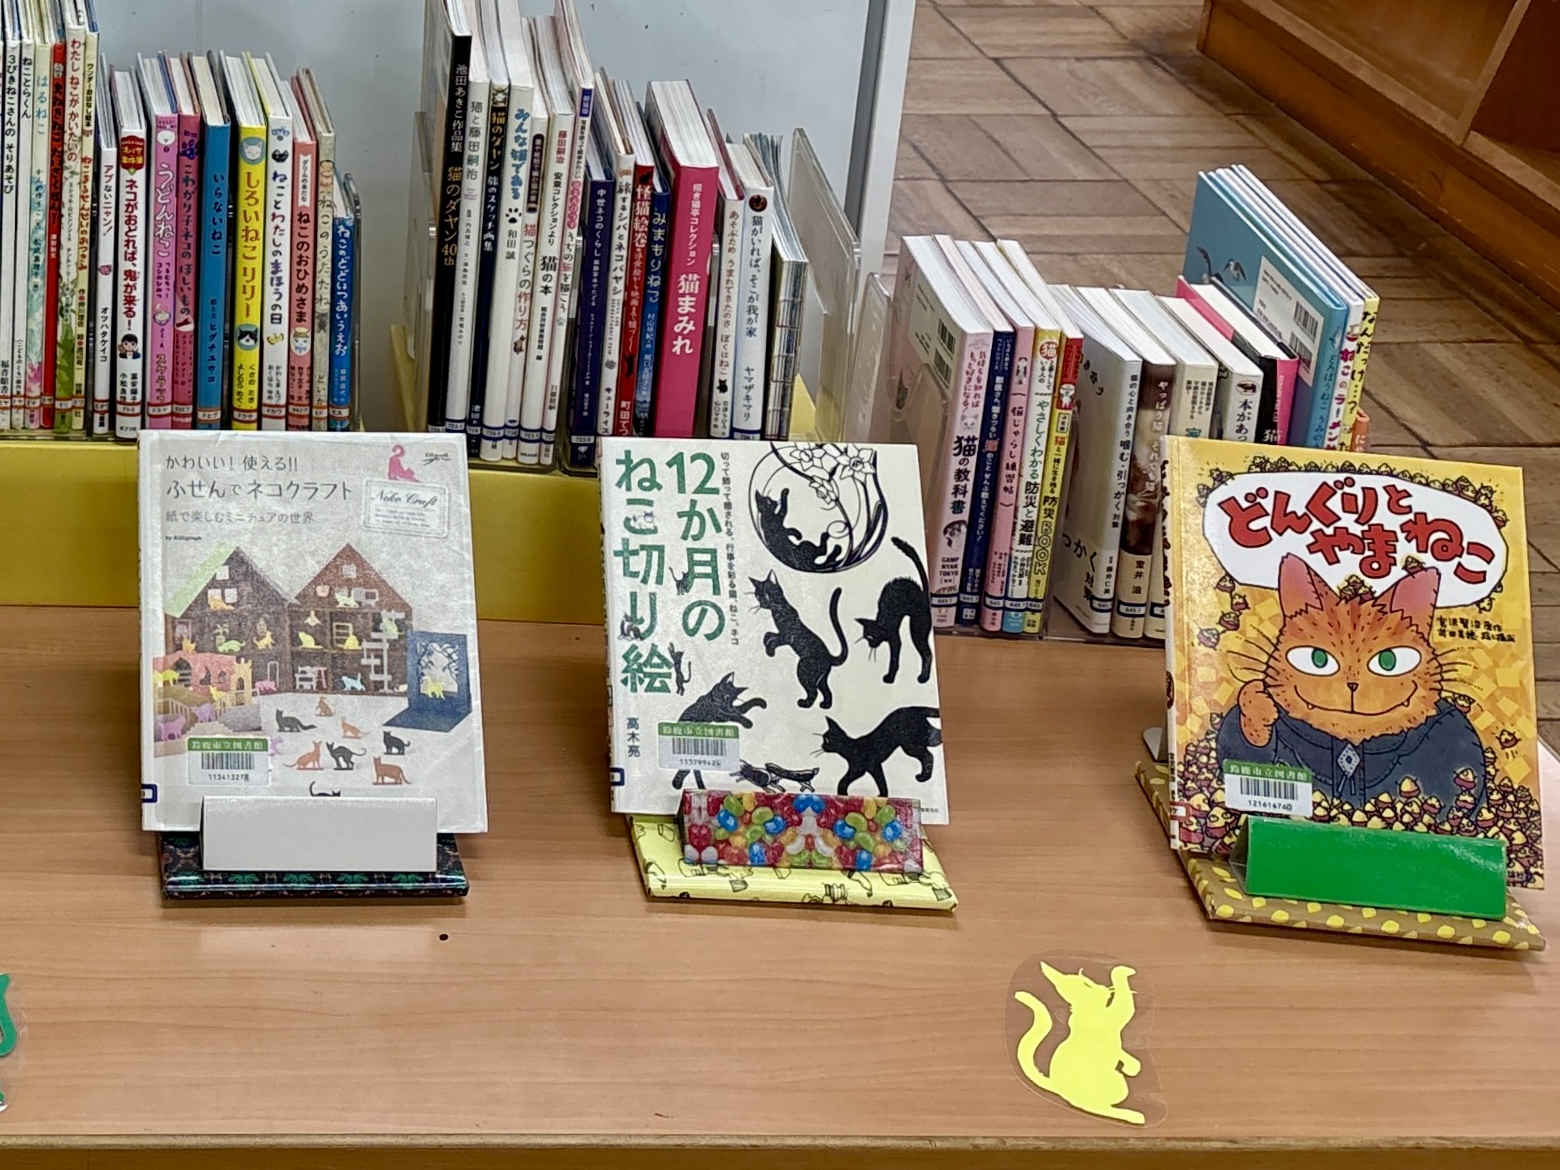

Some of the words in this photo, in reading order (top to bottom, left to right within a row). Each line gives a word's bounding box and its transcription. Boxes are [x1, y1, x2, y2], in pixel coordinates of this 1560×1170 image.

[5, 54, 17, 137] 3びきねこさんの
[21, 57, 32, 119] ねことらくん
[36, 76, 48, 135] はるねこ
[451, 64, 468, 153] 池田あきこ作品集
[4, 143, 15, 194] そりあそび
[466, 101, 483, 181] 猫と藤田嗣治
[489, 112, 505, 170] 猫のダヤン
[510, 108, 530, 200] みんな猫である
[555, 131, 568, 164] 藤田嗣治
[155, 163, 176, 258] うどんねこ
[181, 164, 198, 260] こわがり子ネコの
[210, 174, 225, 256] いらないねこ
[241, 172, 261, 261] しろいねこ
[594, 189, 608, 256] 中世ネコのくらし
[612, 181, 632, 296] 旅するシバとネコバヤシ
[633, 183, 653, 248] 怪猫絵巻
[686, 183, 703, 266] 招き猫亭コレクション
[178, 264, 191, 316] ほしいもの
[240, 266, 256, 320] リリー
[294, 211, 310, 323] ねこのおひめさま
[514, 222, 537, 332] 猫つぐらの作り方
[539, 255, 558, 296] 猫の本
[744, 215, 764, 338] 猫がいれば、そこが我が家
[672, 273, 700, 356] 猫まみれ
[207, 323, 216, 383] ヒグチユウコ
[601, 387, 612, 434] キューライス
[741, 366, 756, 423] ヤマザキマリ
[950, 435, 979, 516] 猫の教科書
[1028, 400, 1050, 482] やさしくわかる
[165, 510, 314, 524] 紙で楽しむミニチュアの世界
[166, 479, 354, 501] ふせんでネコクラフト
[1018, 481, 1041, 547] 防災と避難
[1217, 476, 1414, 549] どんぐりと
[614, 449, 674, 694] ねこ切り絵
[666, 452, 726, 641] 12か月の
[1307, 512, 1496, 586] やまねこ
[626, 717, 642, 759] 高木亮
